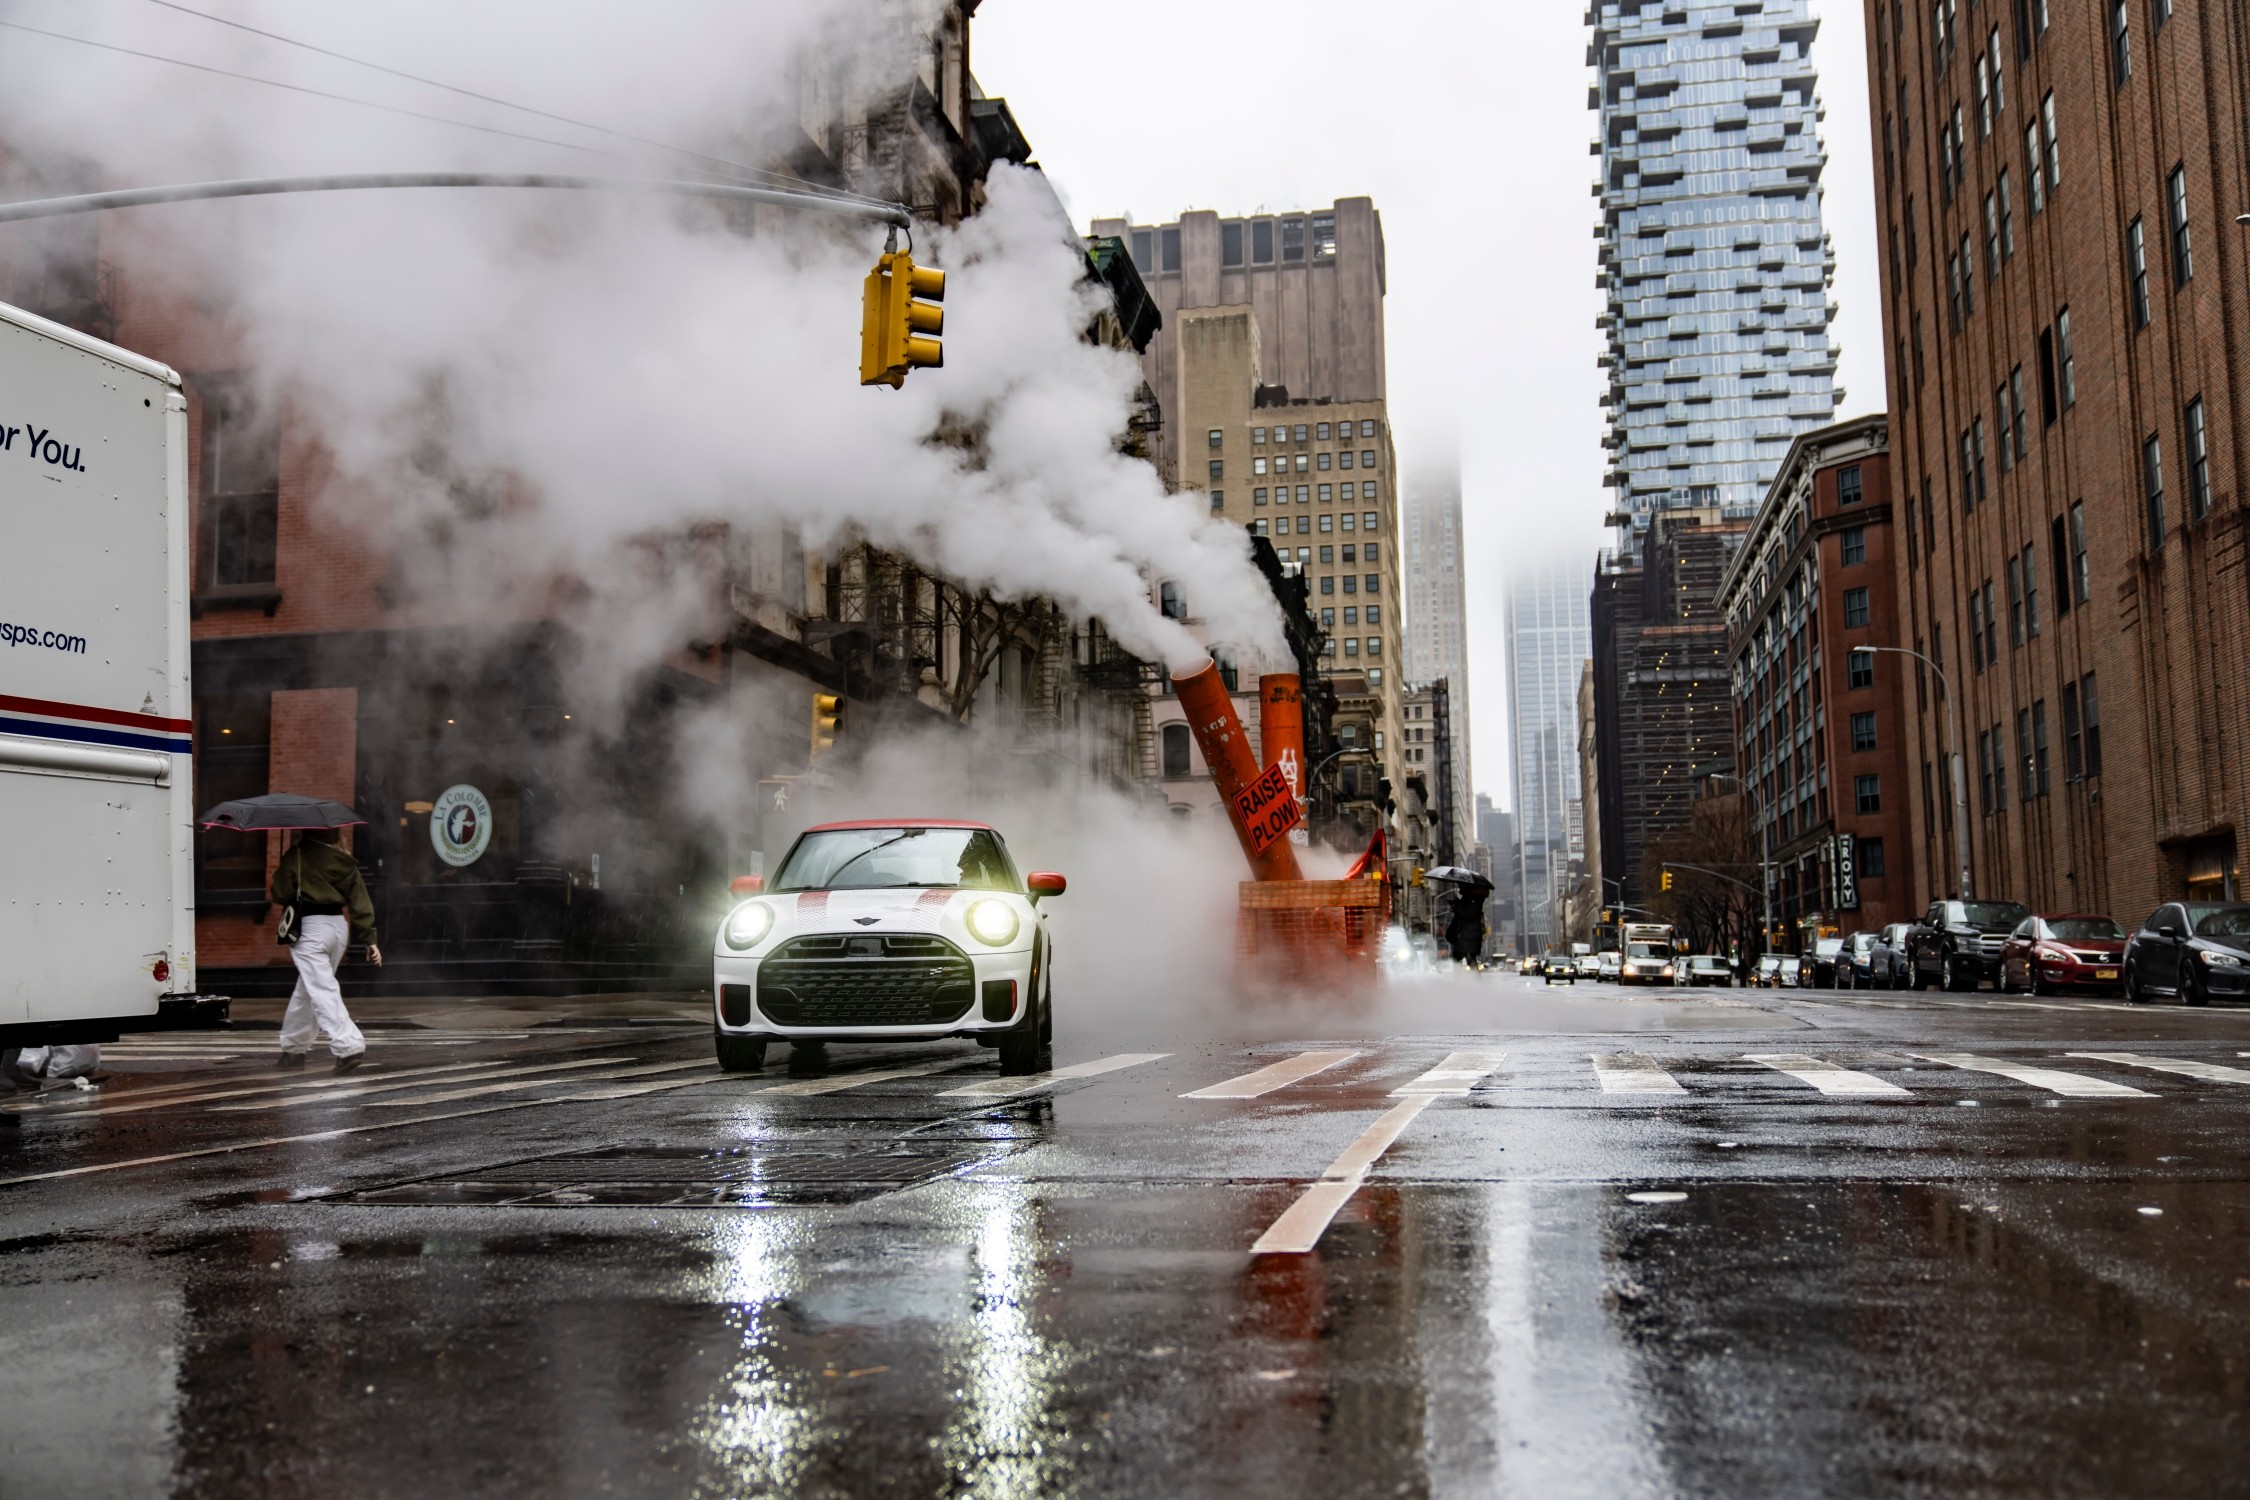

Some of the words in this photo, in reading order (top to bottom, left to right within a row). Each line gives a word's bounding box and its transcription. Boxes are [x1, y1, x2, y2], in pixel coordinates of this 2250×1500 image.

[26, 423, 86, 472] You.
[0, 622, 86, 655] sps.com
[1239, 770, 1285, 820] RAISE
[1252, 799, 1295, 849] PLOW
[1842, 846, 1853, 901] ROXY
